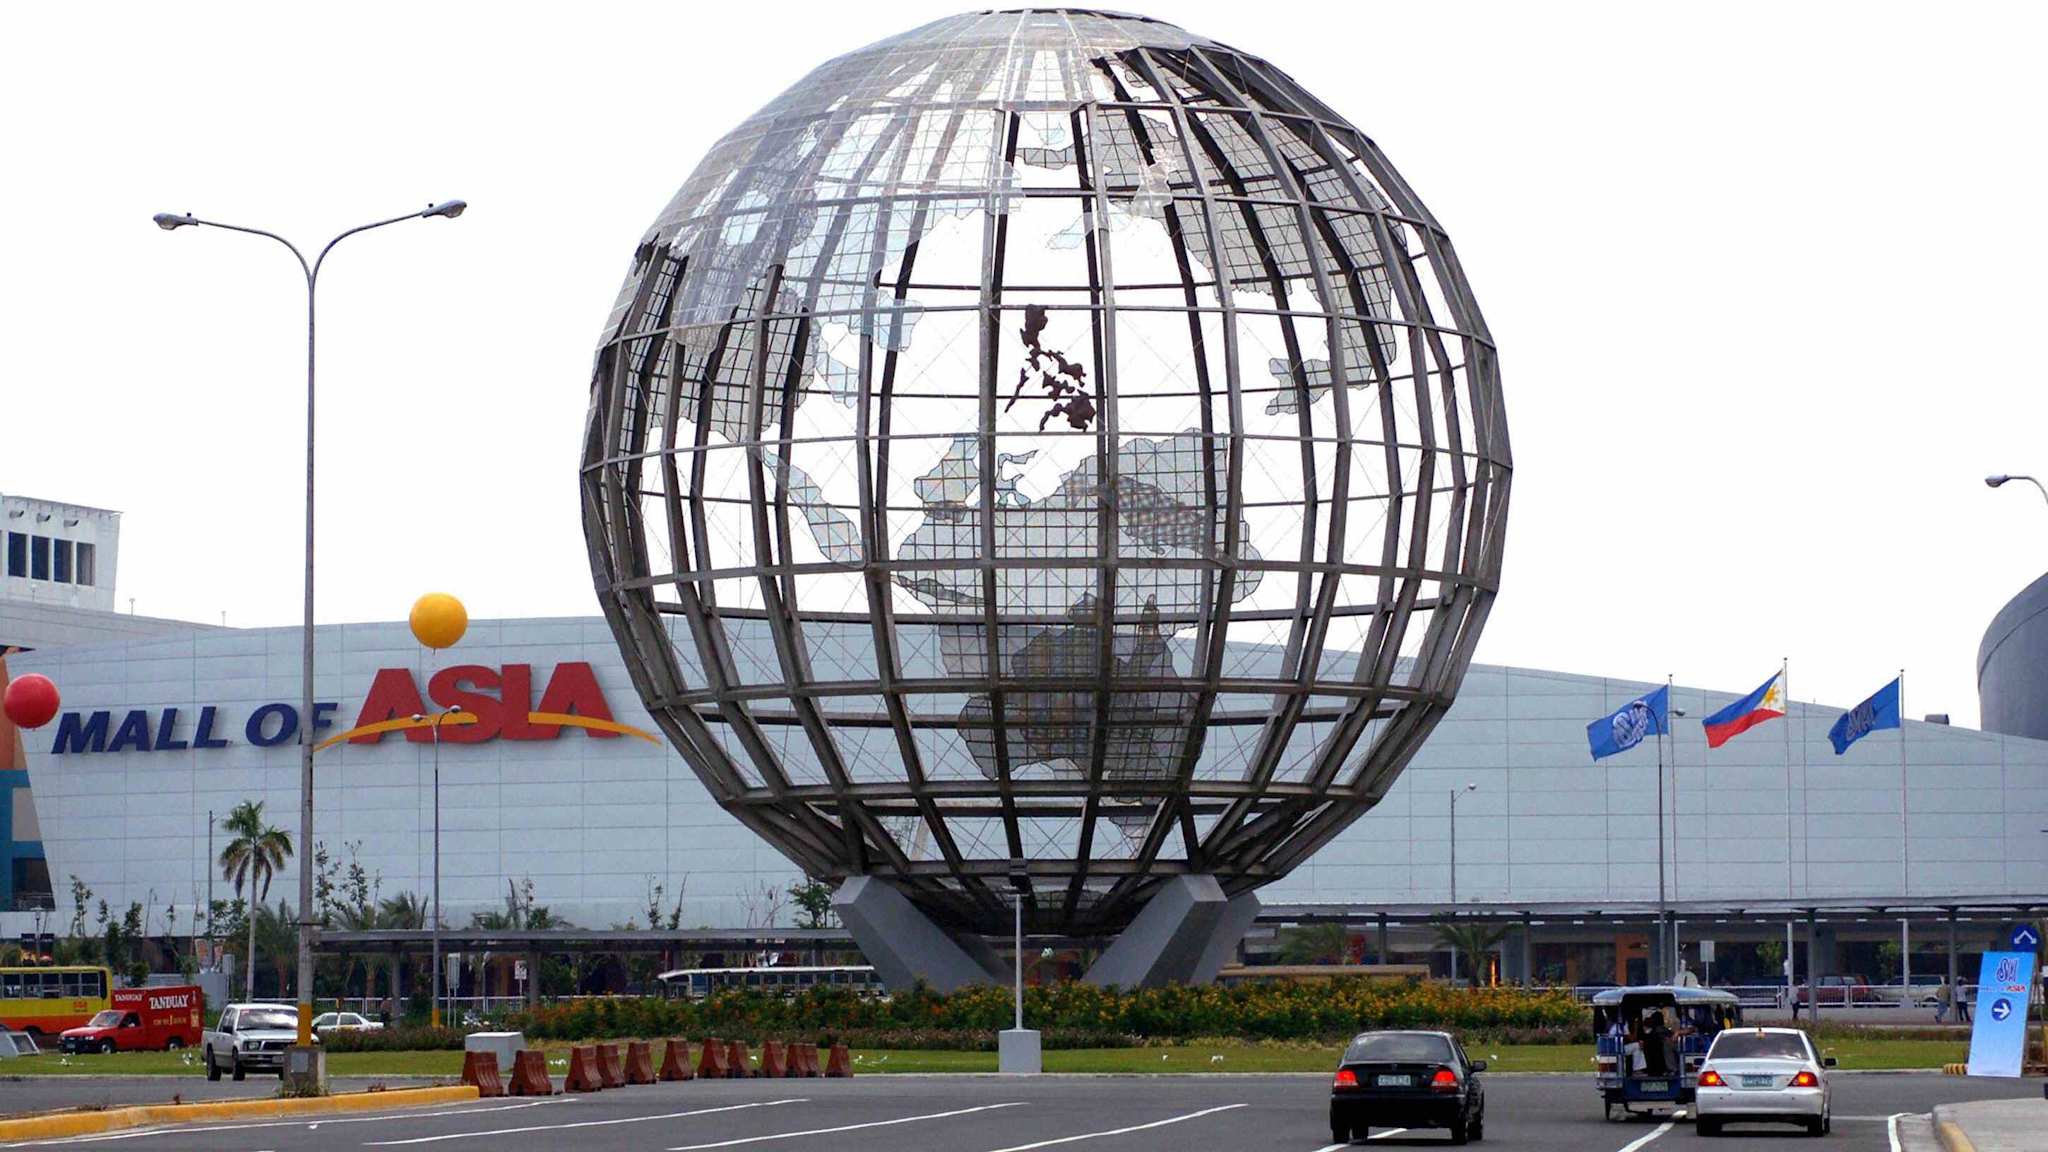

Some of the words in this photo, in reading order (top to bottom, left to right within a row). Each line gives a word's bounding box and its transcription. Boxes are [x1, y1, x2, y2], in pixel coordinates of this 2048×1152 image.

[51, 704, 228, 755] MALL
[245, 702, 338, 747] OF
[348, 661, 622, 745] ASIA
[1996, 958, 2018, 983] SM
[114, 993, 143, 1002] TANDUAY
[149, 994, 189, 1010] TANDUAY
